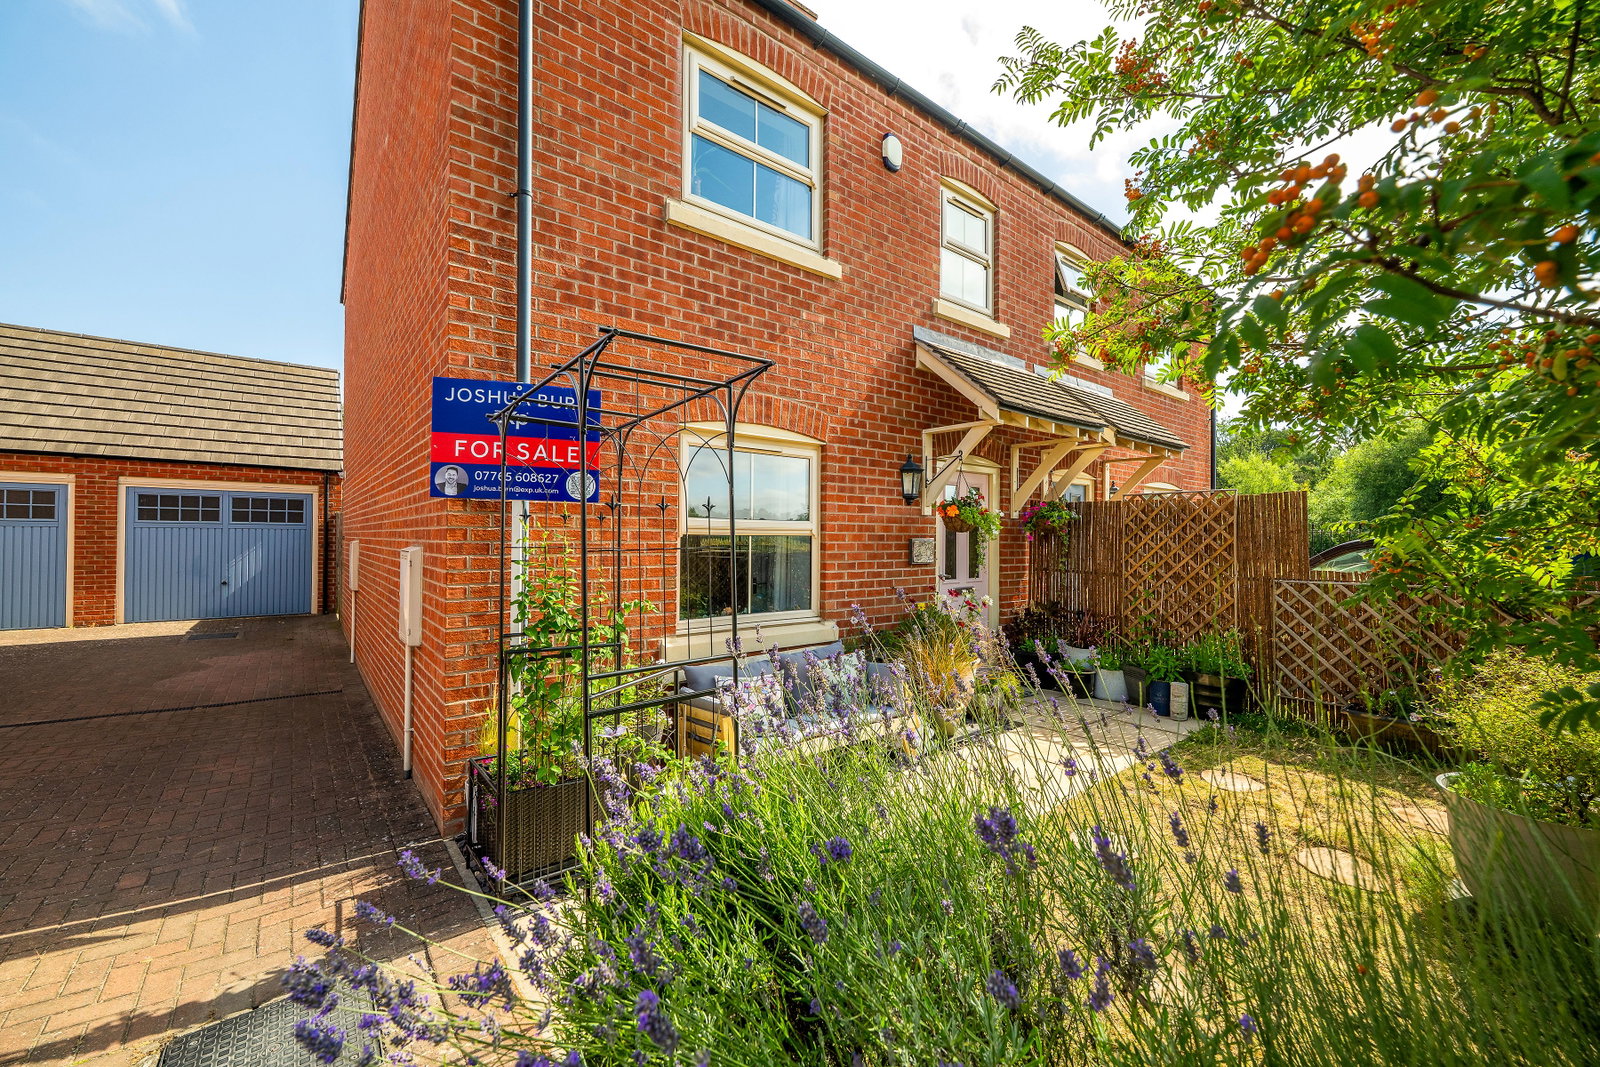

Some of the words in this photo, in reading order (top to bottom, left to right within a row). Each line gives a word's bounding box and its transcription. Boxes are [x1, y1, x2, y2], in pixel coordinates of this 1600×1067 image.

[538, 394, 590, 411] BUR
[455, 440, 504, 459] FOR
[516, 443, 580, 463] SALE
[515, 472, 559, 484] 608627
